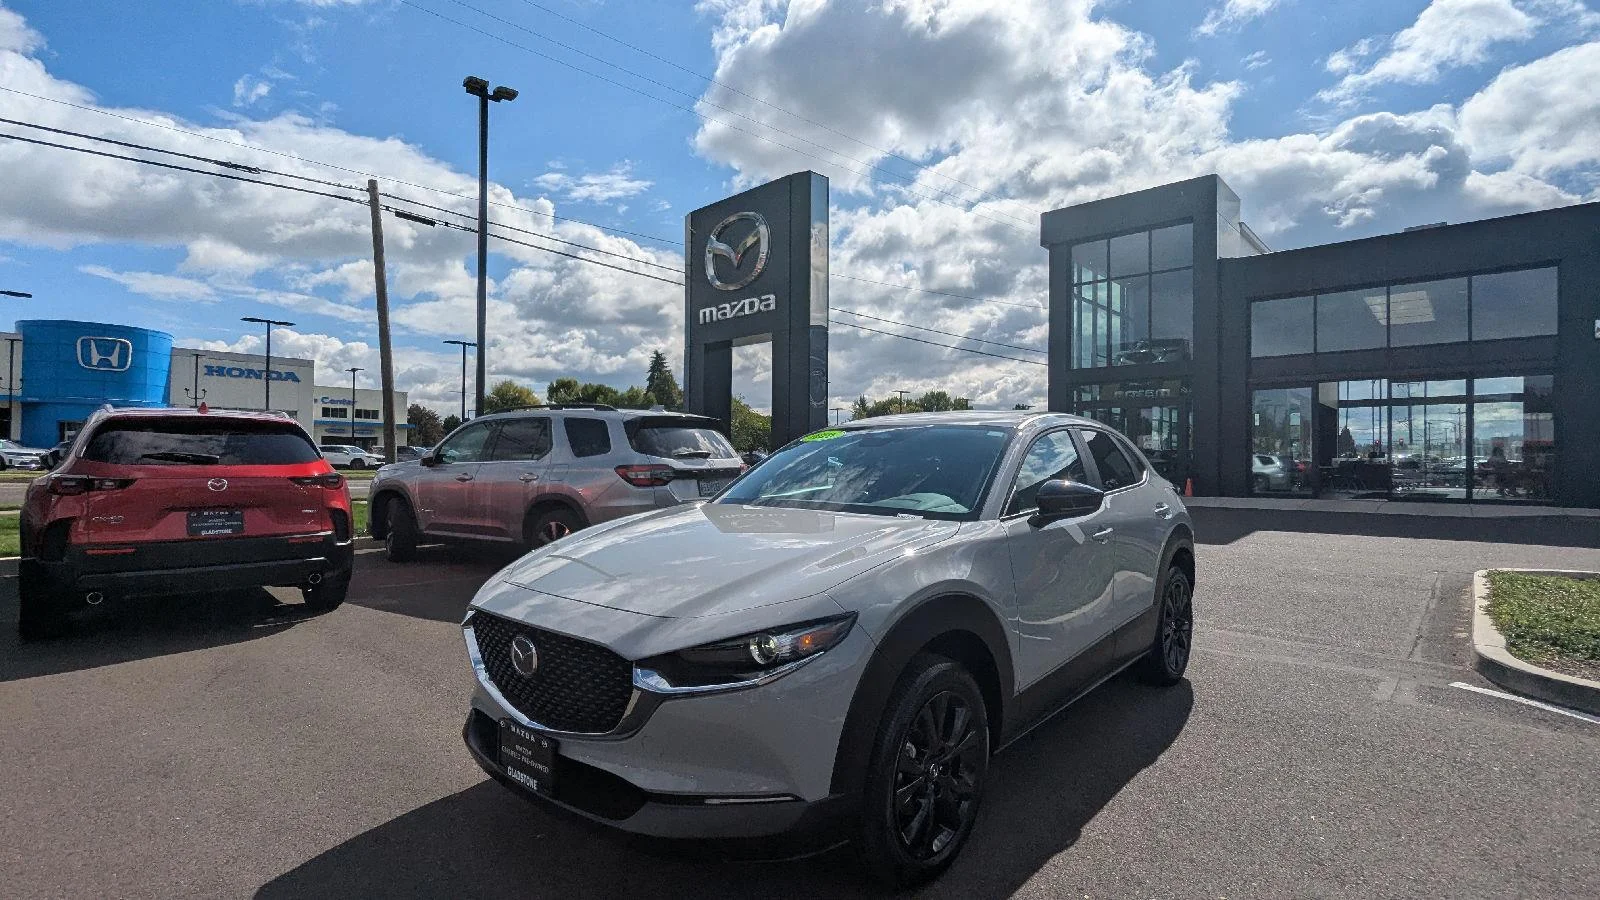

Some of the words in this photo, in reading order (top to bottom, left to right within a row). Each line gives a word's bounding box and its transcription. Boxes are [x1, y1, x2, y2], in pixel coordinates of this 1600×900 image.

[204, 365, 301, 384] HONDA
[510, 724, 536, 743] MAZDA
[507, 765, 538, 790] GLADSTONE
